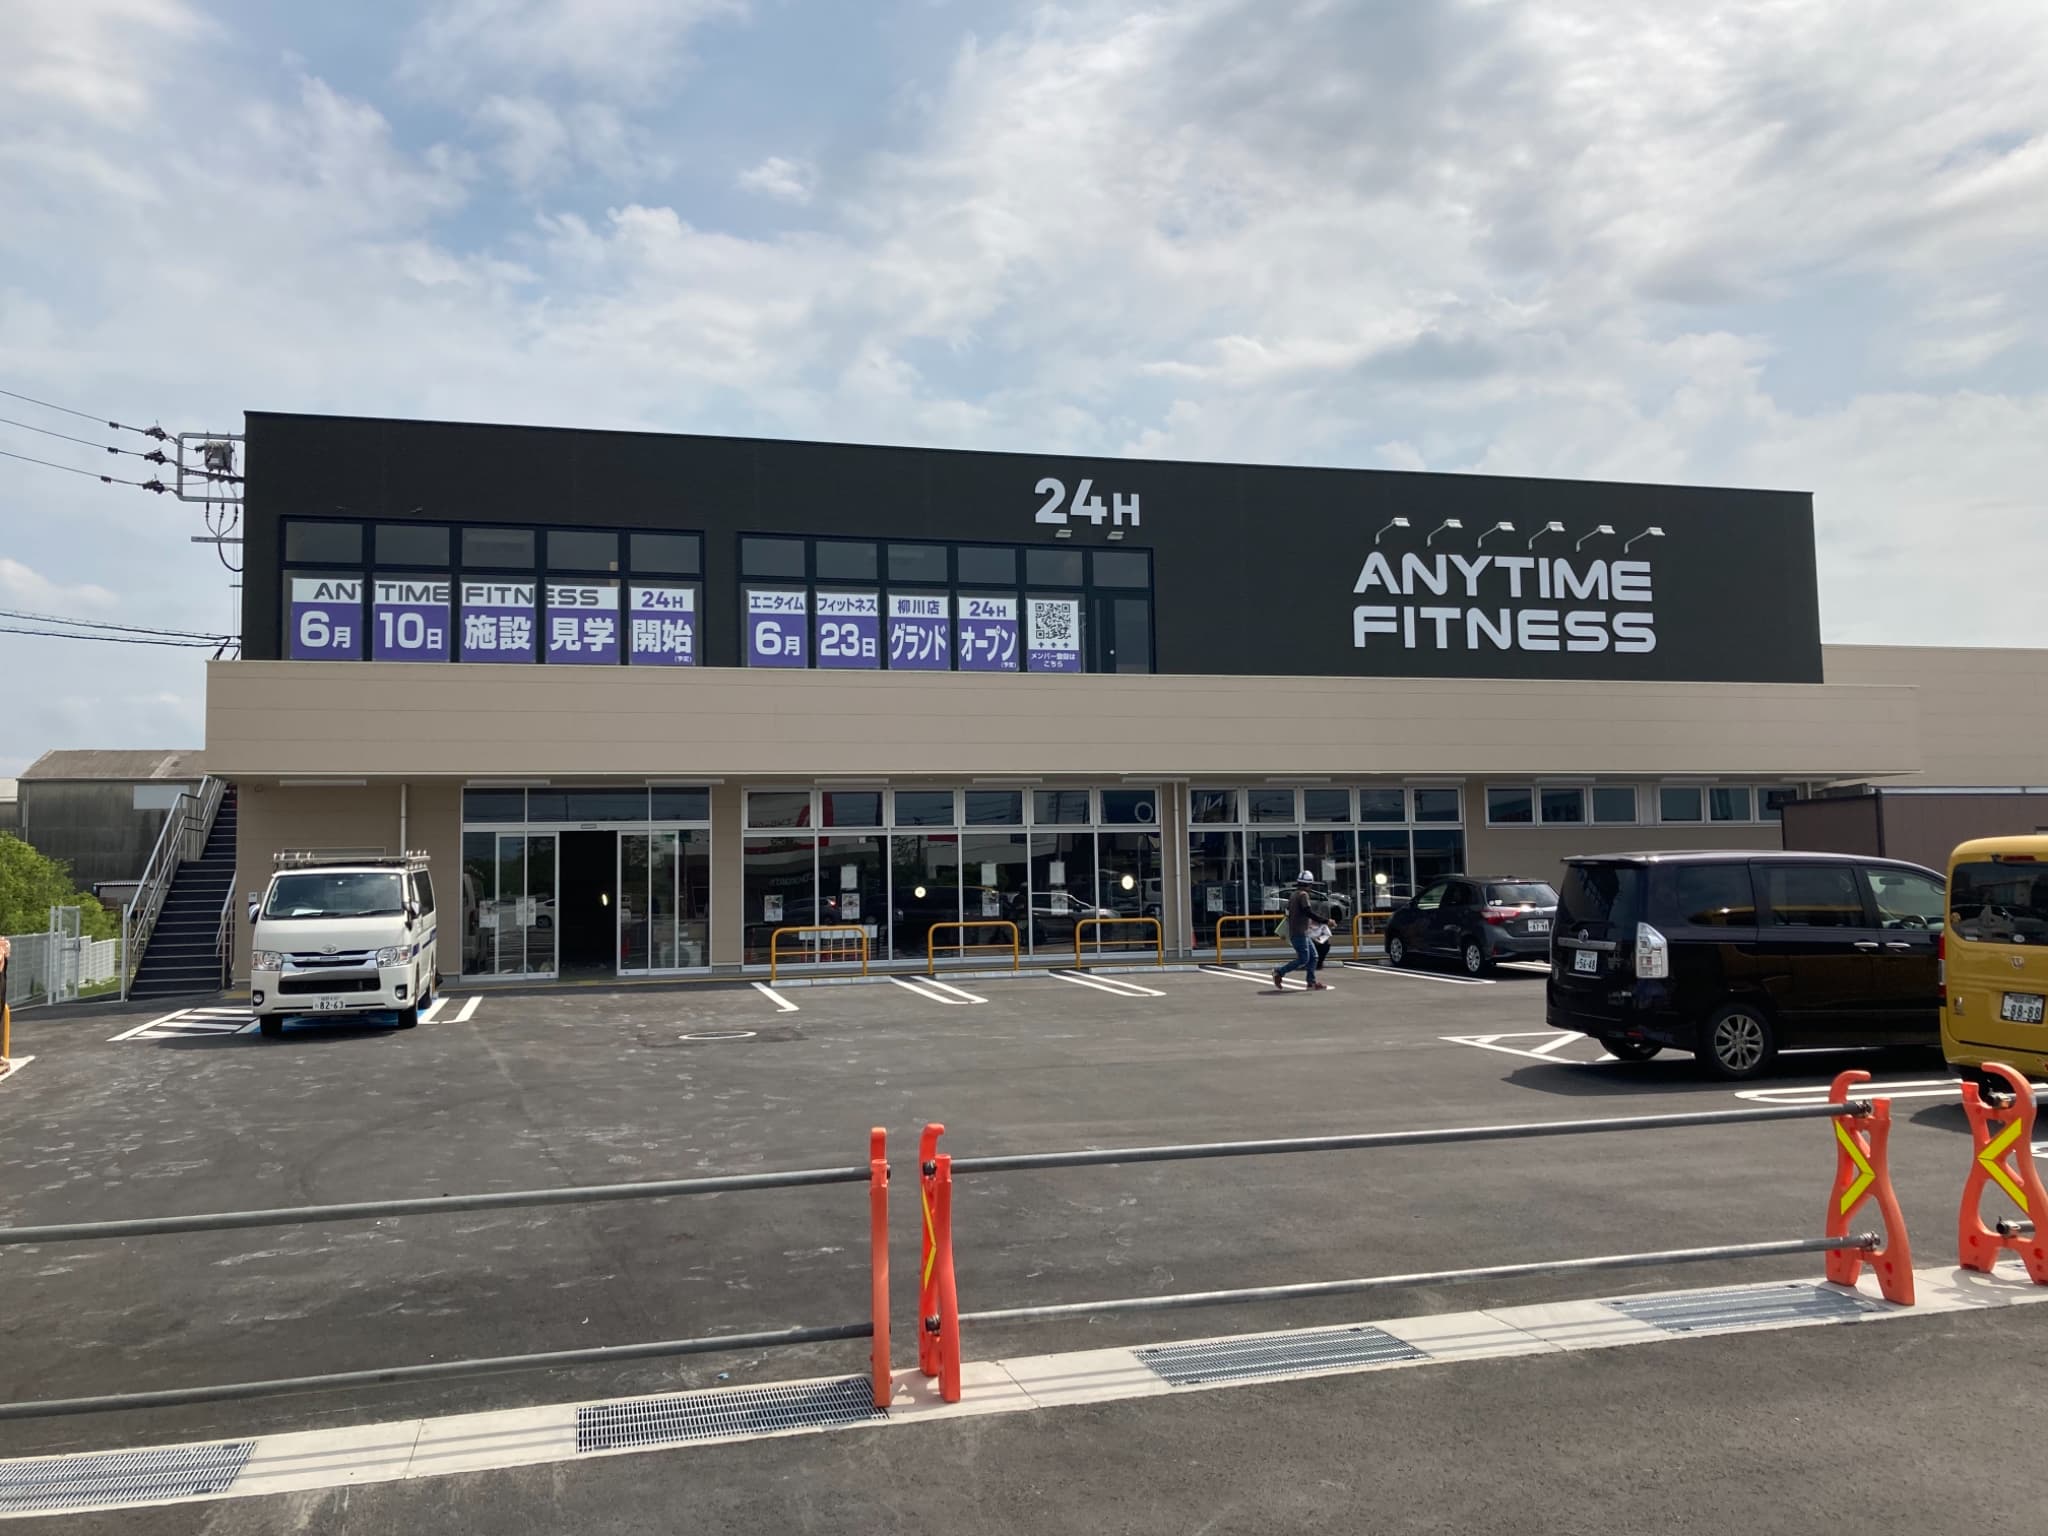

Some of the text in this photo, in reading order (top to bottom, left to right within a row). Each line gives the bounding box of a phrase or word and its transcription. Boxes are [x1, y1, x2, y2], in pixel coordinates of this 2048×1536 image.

[1034, 477, 1140, 526] 24H
[313, 582, 449, 602] ANTIME
[641, 590, 684, 609] 24H
[1353, 551, 1653, 602] ANYTIME
[750, 596, 1007, 618] エニタイム フィットネス 柳川店 24H
[300, 610, 693, 654] 6月 10日 施設 見学 開始
[755, 620, 1017, 662] 6月 23日 グランド オープン
[1353, 605, 1657, 653] FITNESS
[1043, 660, 1064, 668] こちら
